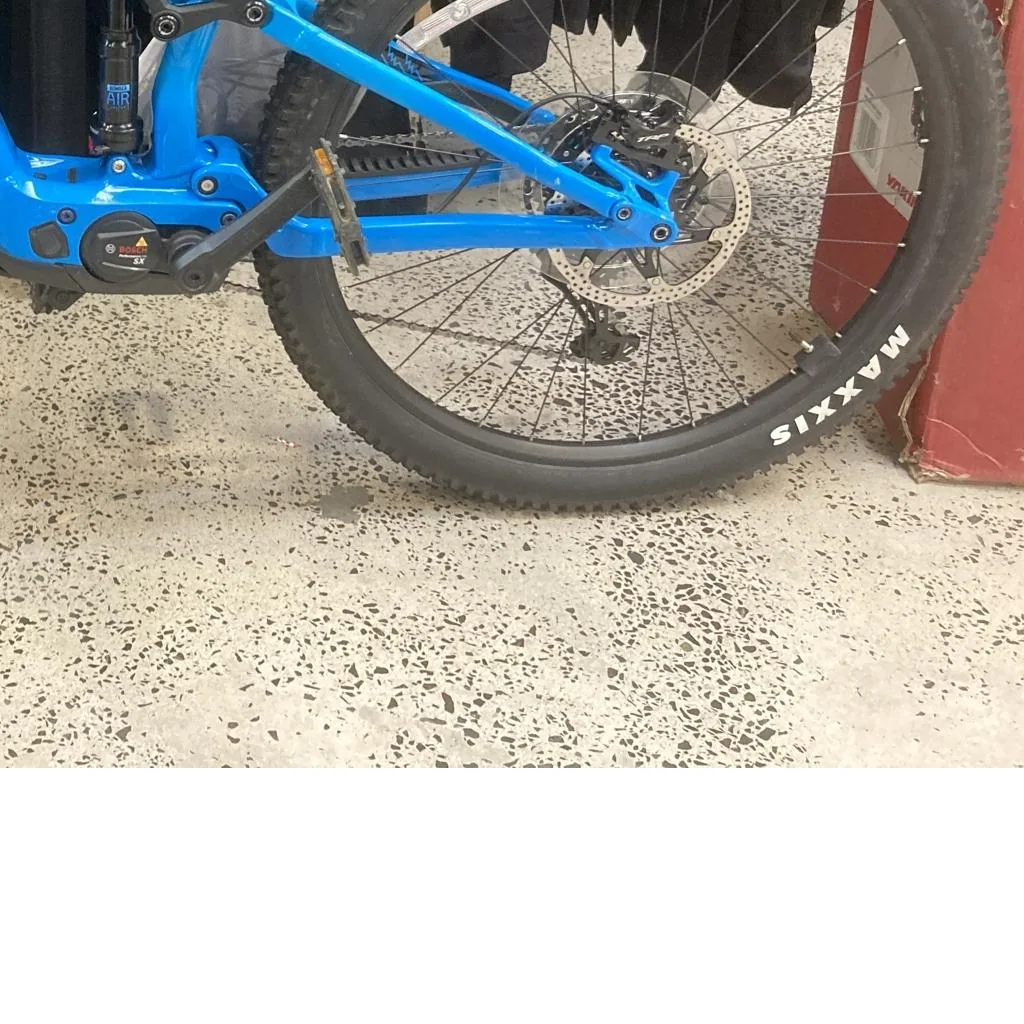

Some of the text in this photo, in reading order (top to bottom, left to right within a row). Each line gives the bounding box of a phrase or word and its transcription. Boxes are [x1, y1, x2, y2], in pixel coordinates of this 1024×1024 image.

[107, 92, 130, 106] AIR
[119, 246, 147, 254] BOSCH
[133, 257, 146, 265] SX
[770, 324, 911, 446] MAXXIS
